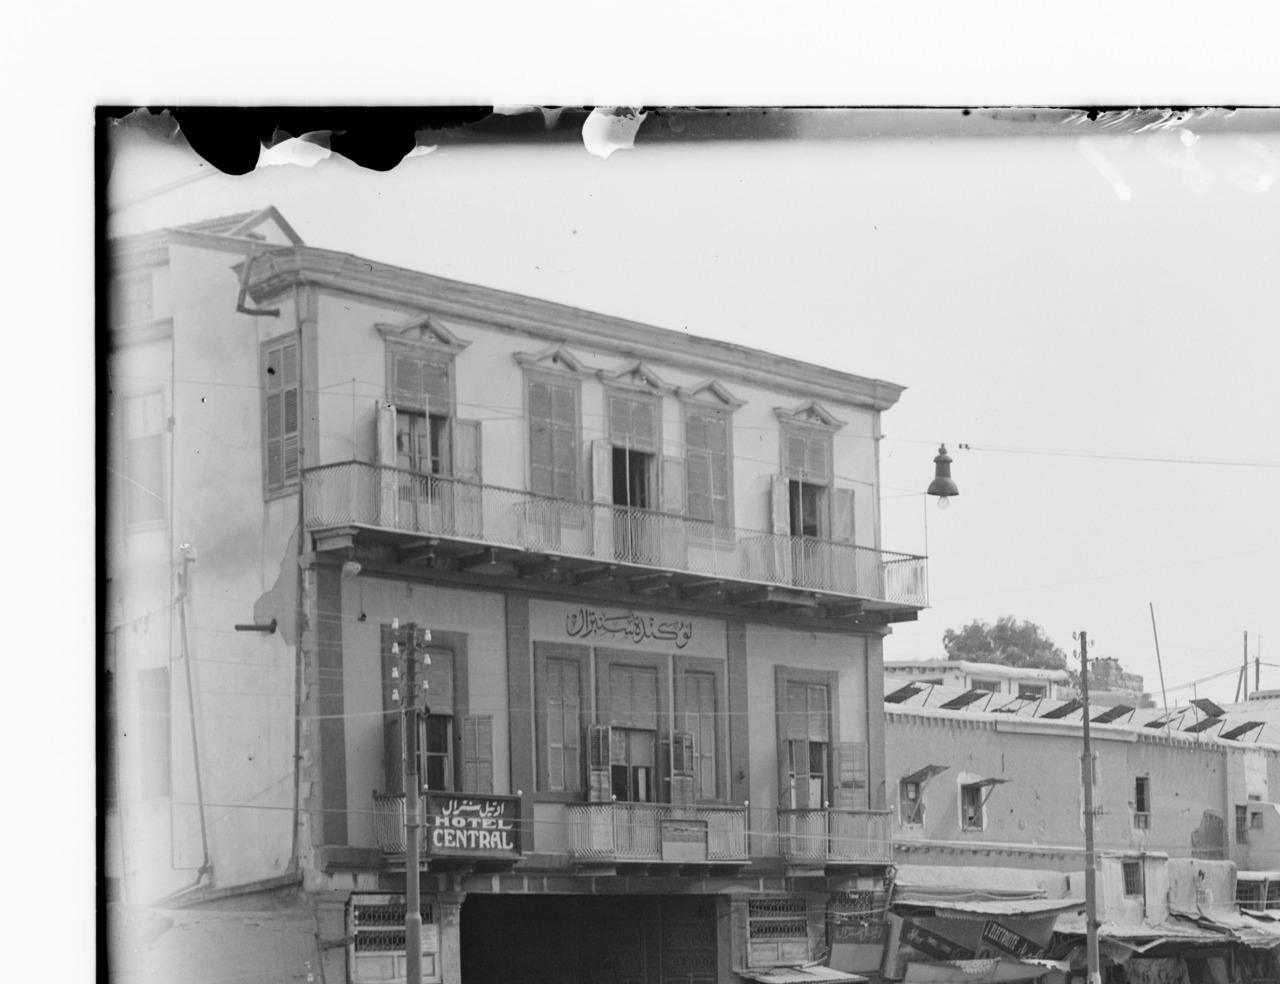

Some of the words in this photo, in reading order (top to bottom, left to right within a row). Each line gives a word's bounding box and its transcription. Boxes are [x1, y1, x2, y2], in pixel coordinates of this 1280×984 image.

[442, 799, 481, 816] سنترال
[479, 800, 505, 817] اوتيل
[435, 815, 513, 830] HOTEL
[433, 828, 514, 850] CENTRAL
